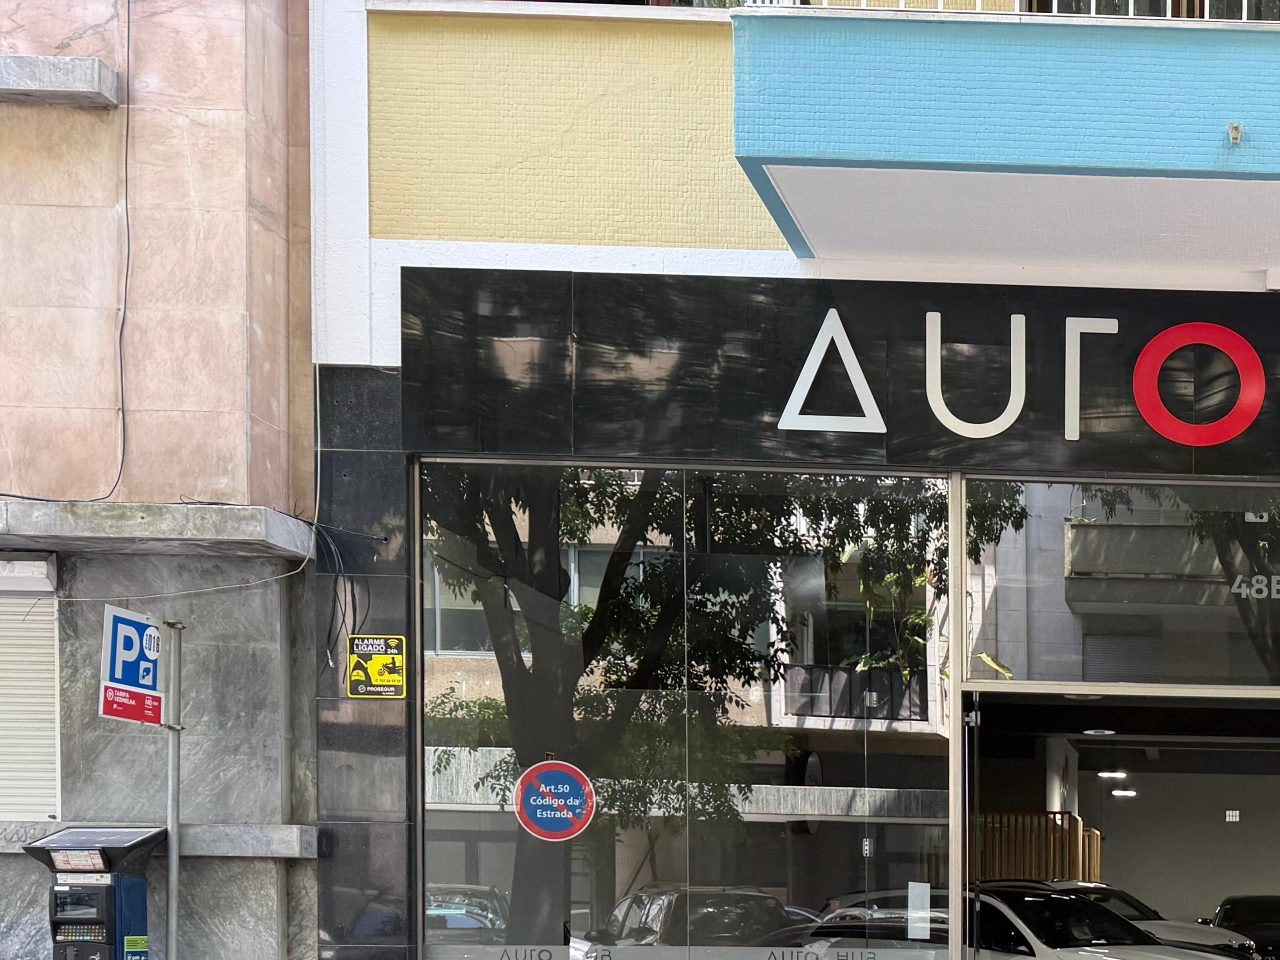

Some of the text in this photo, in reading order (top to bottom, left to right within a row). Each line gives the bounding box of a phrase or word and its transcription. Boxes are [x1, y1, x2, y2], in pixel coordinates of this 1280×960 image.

[777, 308, 1266, 447] AUTO
[115, 623, 140, 679] P
[540, 784, 570, 792] Art.50
[530, 796, 579, 807] Código da
[536, 809, 573, 818] Estrada
